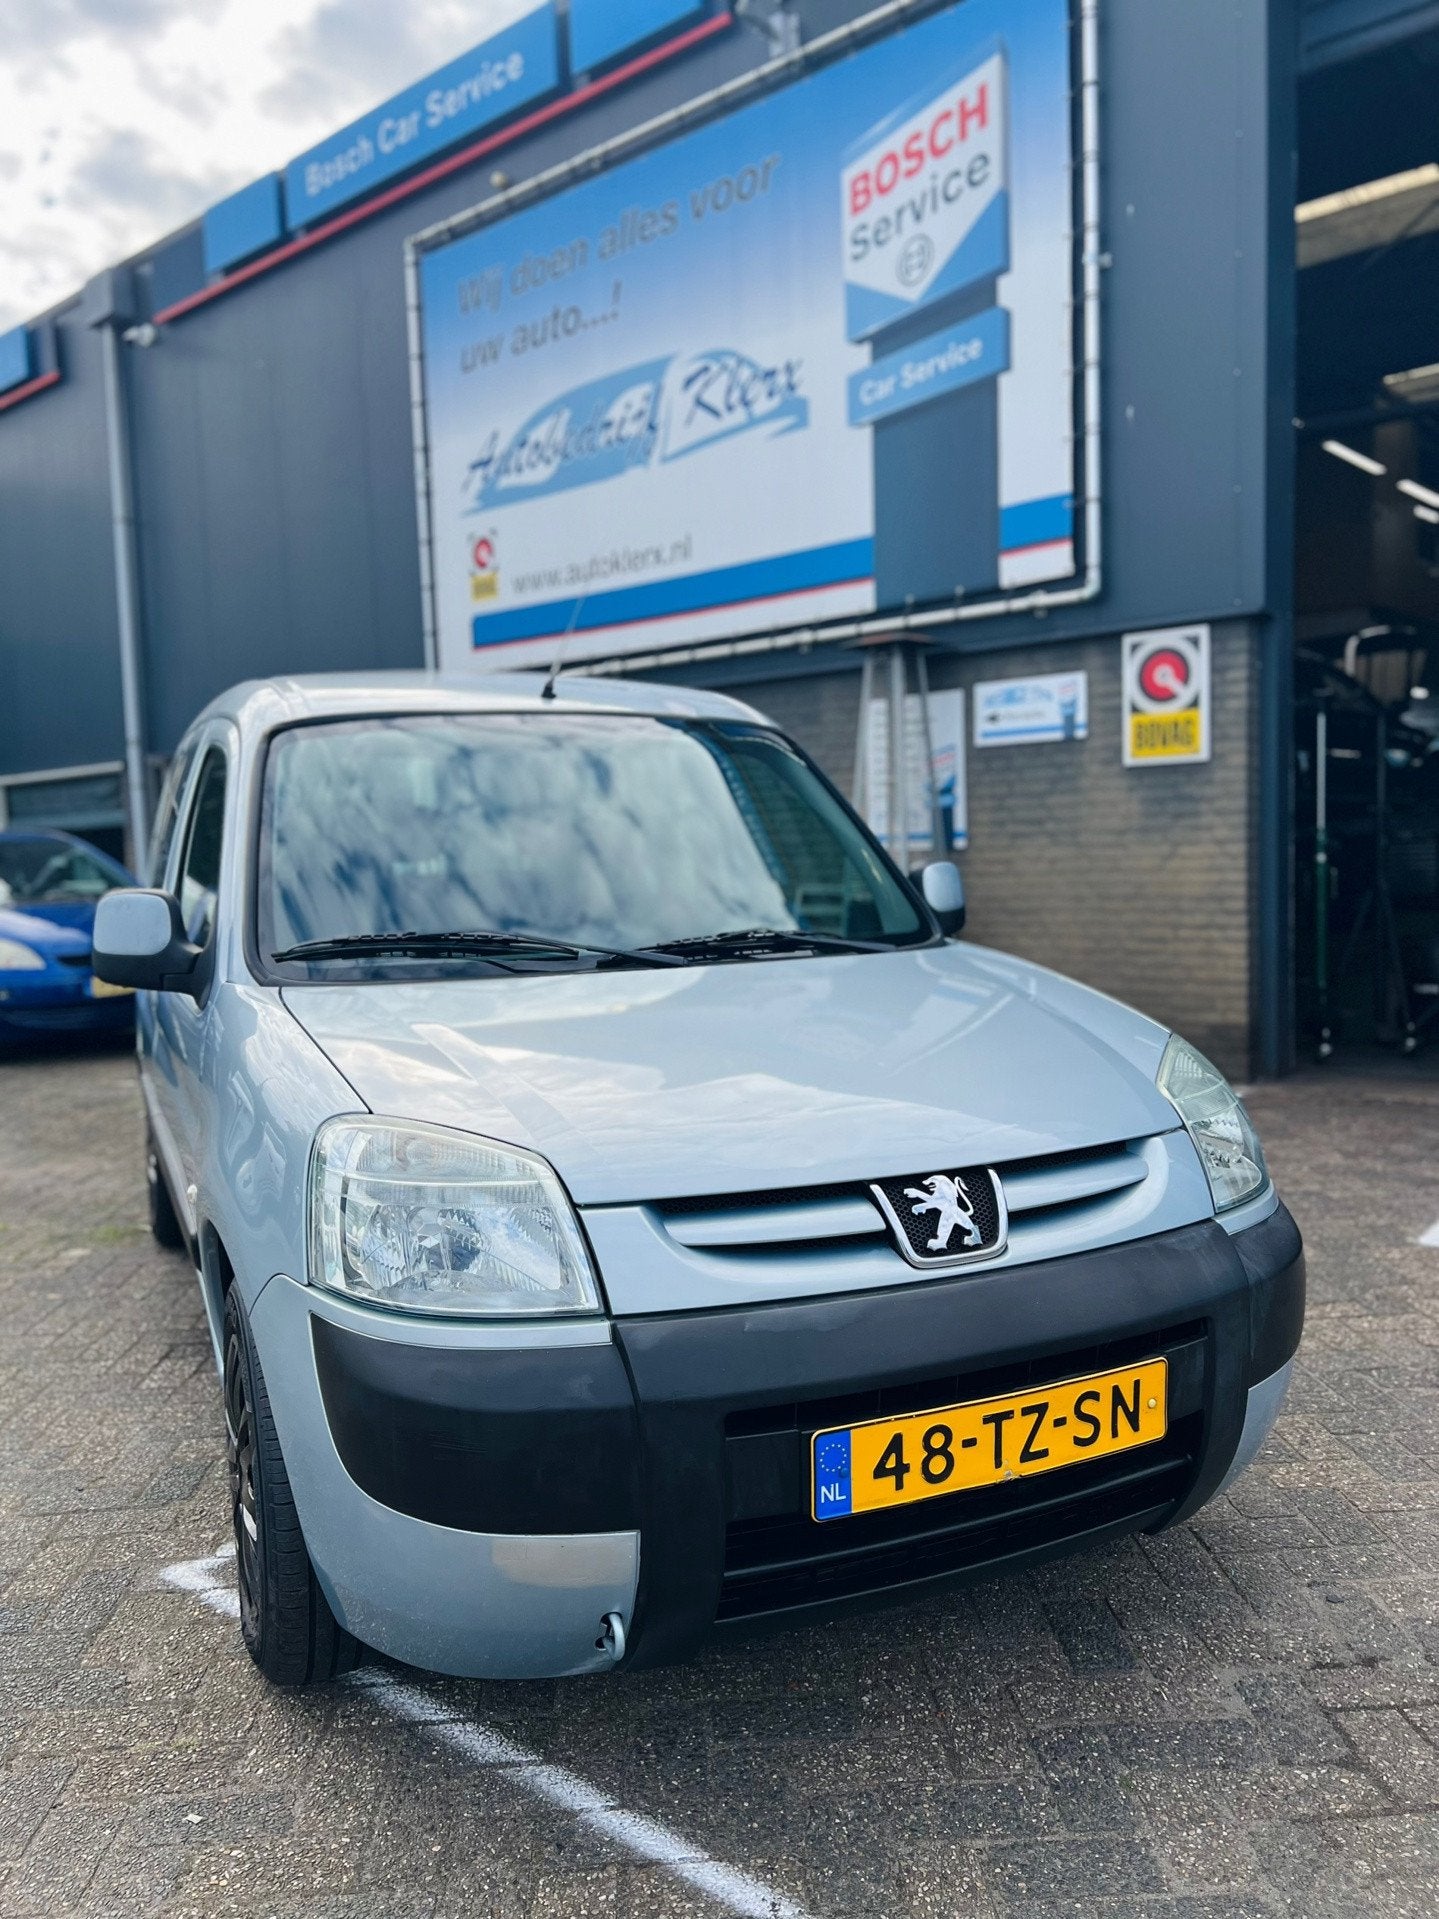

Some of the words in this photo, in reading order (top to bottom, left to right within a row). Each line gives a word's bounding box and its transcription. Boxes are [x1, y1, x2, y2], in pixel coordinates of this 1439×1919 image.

[305, 135, 374, 196] Bosch
[376, 110, 421, 154] Car
[425, 53, 524, 127] Service
[850, 83, 989, 217] BOSCH
[457, 262, 503, 316] Wij
[509, 237, 588, 295] doen
[596, 199, 681, 261] alles
[689, 155, 780, 221] voor
[850, 151, 991, 262] Service
[459, 334, 505, 375] uw
[858, 374, 898, 407] Car
[901, 338, 983, 388] Service
[1134, 716, 1195, 752] BOVAG
[872, 1378, 1142, 1492] 48-TZ-SN
[819, 1482, 848, 1504] NL
